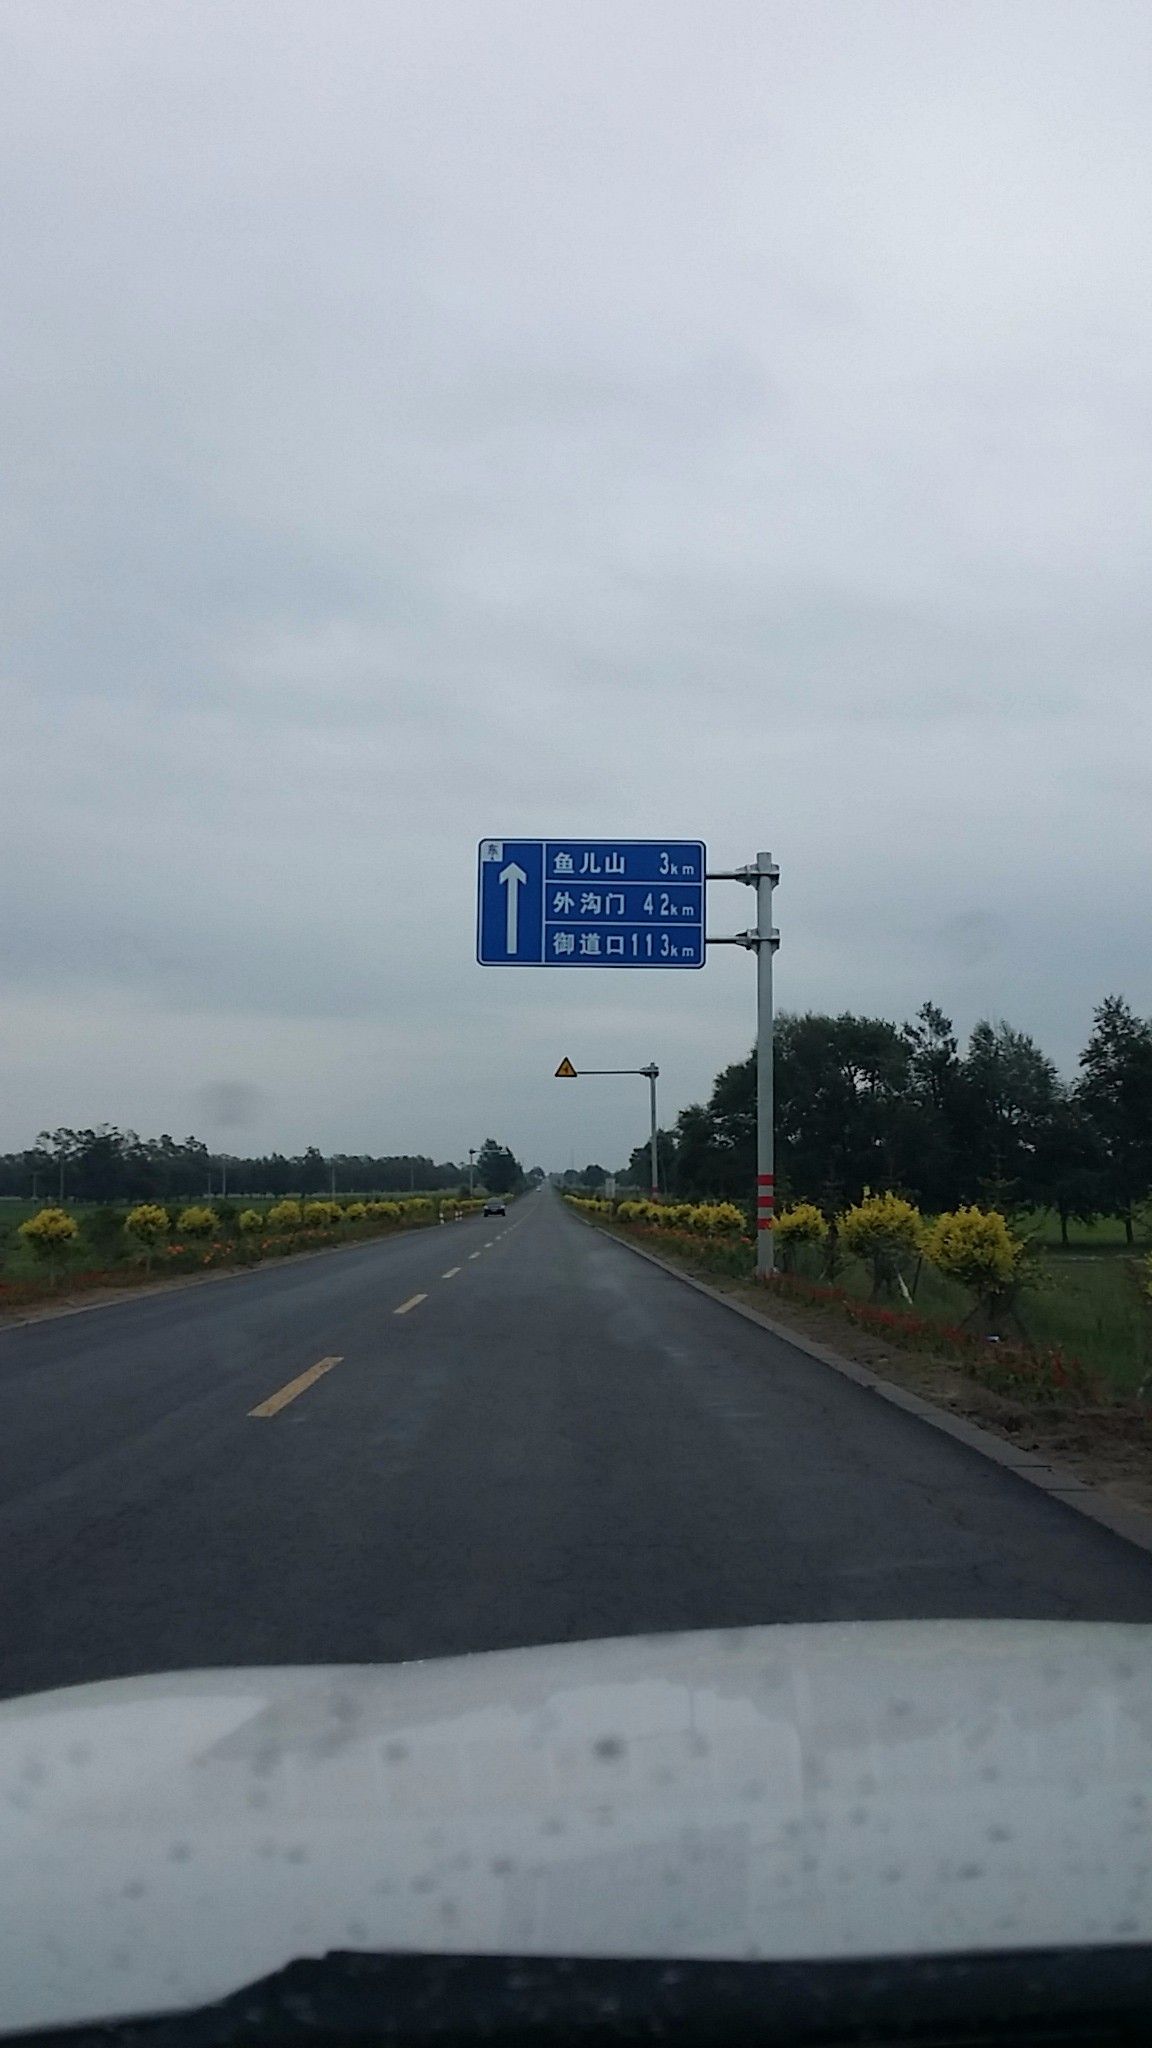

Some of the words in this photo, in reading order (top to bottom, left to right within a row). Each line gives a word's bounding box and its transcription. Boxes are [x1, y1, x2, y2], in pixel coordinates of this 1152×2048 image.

[553, 852, 625, 874] 鱼儿山
[659, 852, 694, 875] 3km
[553, 891, 625, 915] 外沟门
[643, 893, 694, 916] 42km
[553, 932, 625, 955] 御道口
[631, 933, 694, 957] 113km
